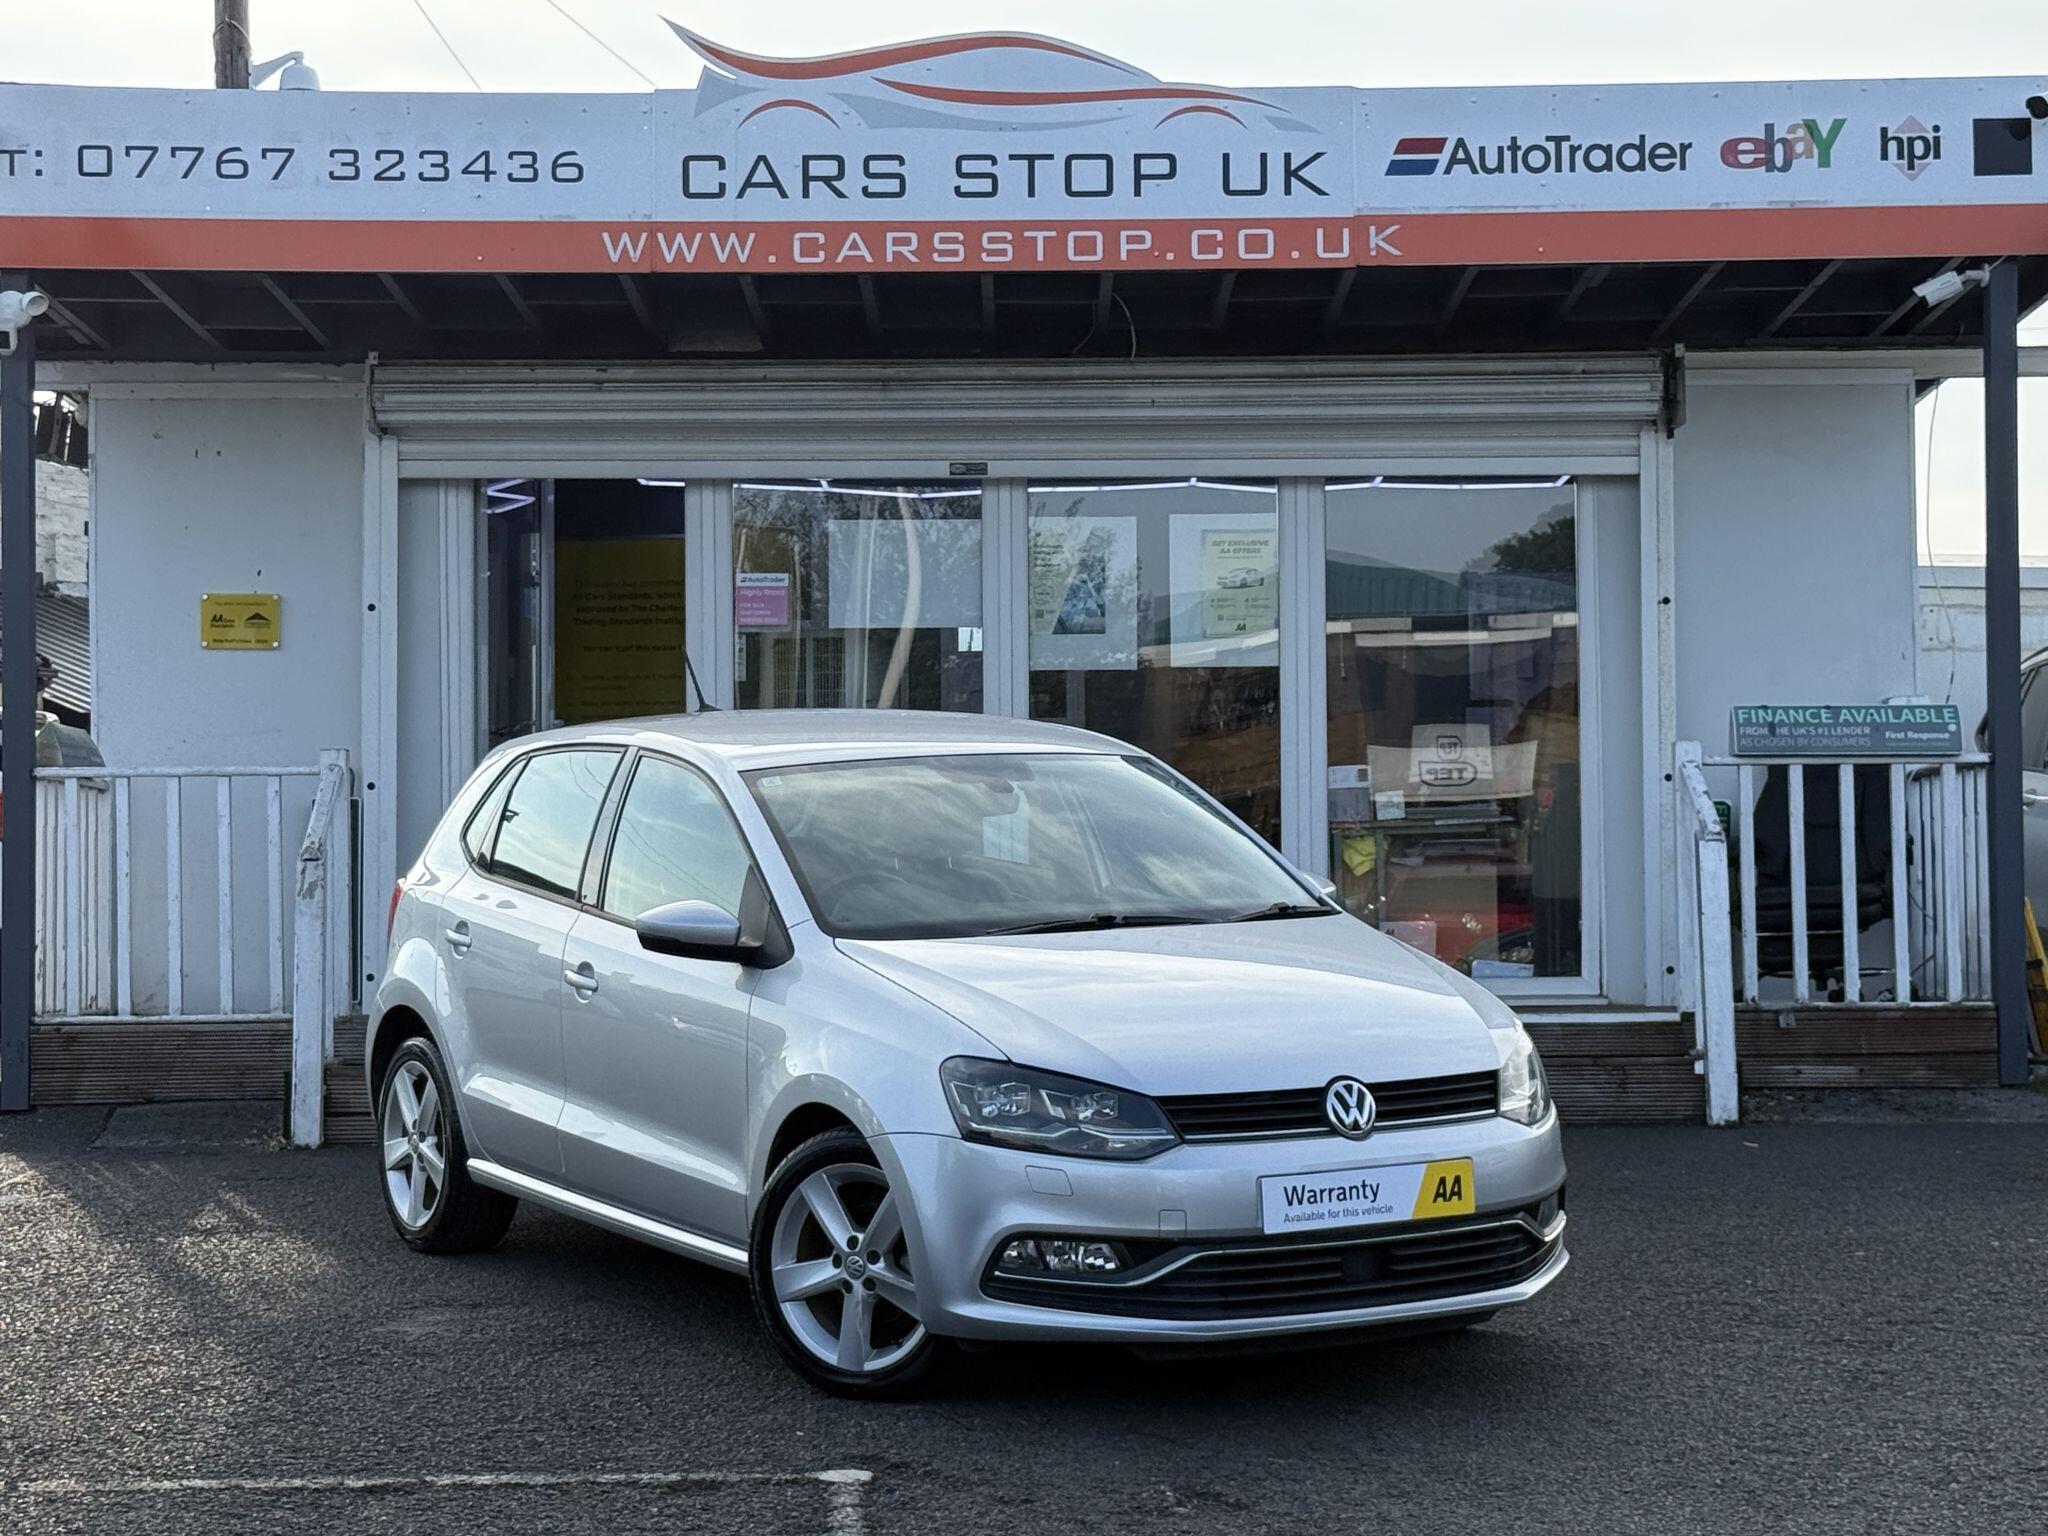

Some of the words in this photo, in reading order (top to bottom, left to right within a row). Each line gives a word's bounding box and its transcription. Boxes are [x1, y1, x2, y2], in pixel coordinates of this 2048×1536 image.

[0, 149, 43, 177] T:
[78, 145, 296, 180] 07767
[328, 147, 586, 183] 323436
[1443, 134, 1693, 175] AutoTrader
[1880, 125, 1942, 171] hpi
[682, 154, 907, 199] CARS
[953, 153, 1177, 199] STOP
[1222, 152, 1330, 197] UK
[602, 225, 1402, 264] WWW.CARSSTOP.CO.UK
[1737, 708, 1834, 724] FINANCE
[1839, 707, 1958, 724] AVAILABLE
[1740, 726, 1769, 736] FROM
[1791, 727, 1816, 736] UK'S
[1831, 727, 1871, 736] LENDER
[1754, 737, 1795, 747] CHOSEN
[1810, 737, 1872, 747] CONSUMERS
[1885, 731, 1905, 739] First
[1907, 731, 1951, 741] Response
[1283, 1178, 1380, 1207] Warranty
[1432, 1175, 1463, 1204] AA
[1283, 1208, 1326, 1223] Available
[1328, 1206, 1341, 1219] for
[1343, 1204, 1359, 1218] this
[1361, 1203, 1394, 1215] vehicle
